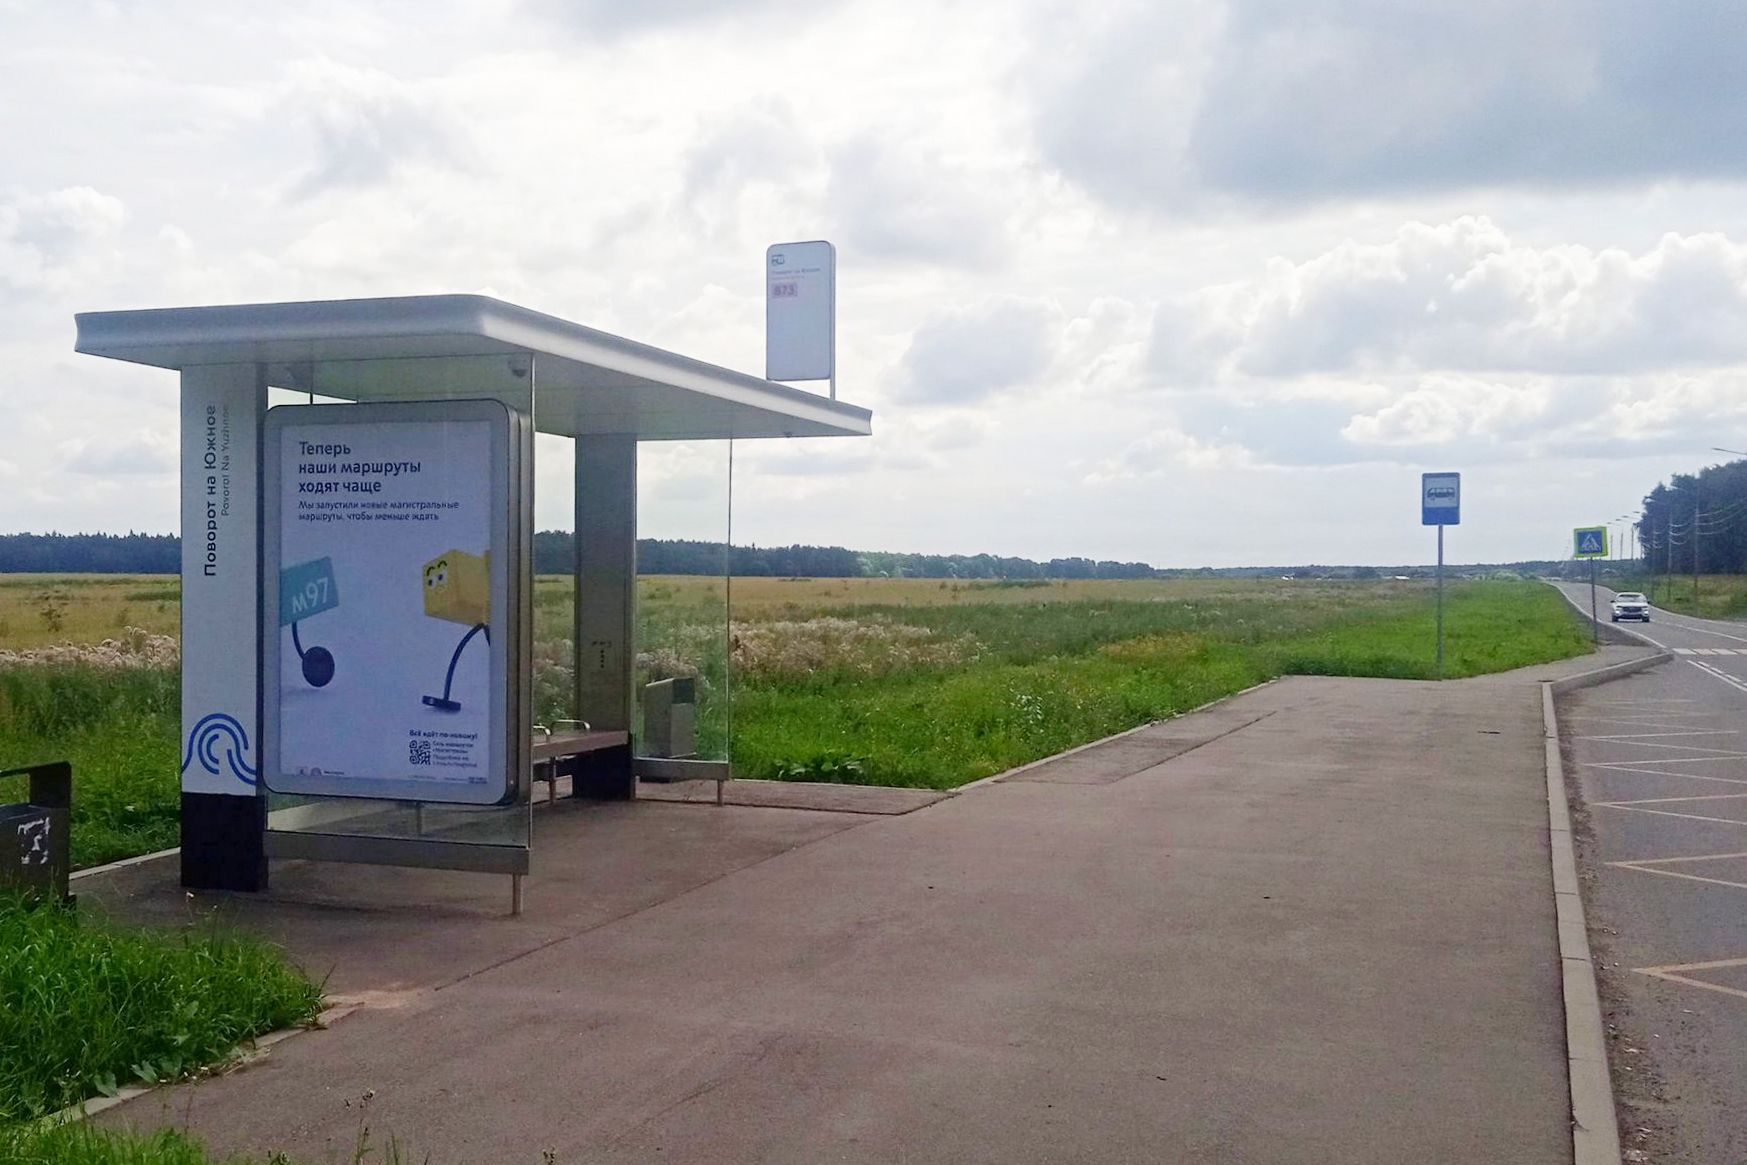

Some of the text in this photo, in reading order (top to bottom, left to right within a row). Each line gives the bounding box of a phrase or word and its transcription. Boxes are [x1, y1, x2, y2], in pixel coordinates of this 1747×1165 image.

[299, 441, 352, 458] Теперь
[222, 455, 230, 471] Na
[299, 461, 421, 476] наши маршруты
[204, 405, 217, 577] Поворот на Южное
[299, 481, 382, 494] ходят чаще
[299, 501, 314, 509] Мы
[316, 501, 358, 512] запустили
[390, 501, 459, 512] магистральные
[346, 511, 373, 521] чтобы
[411, 513, 439, 521] ждать
